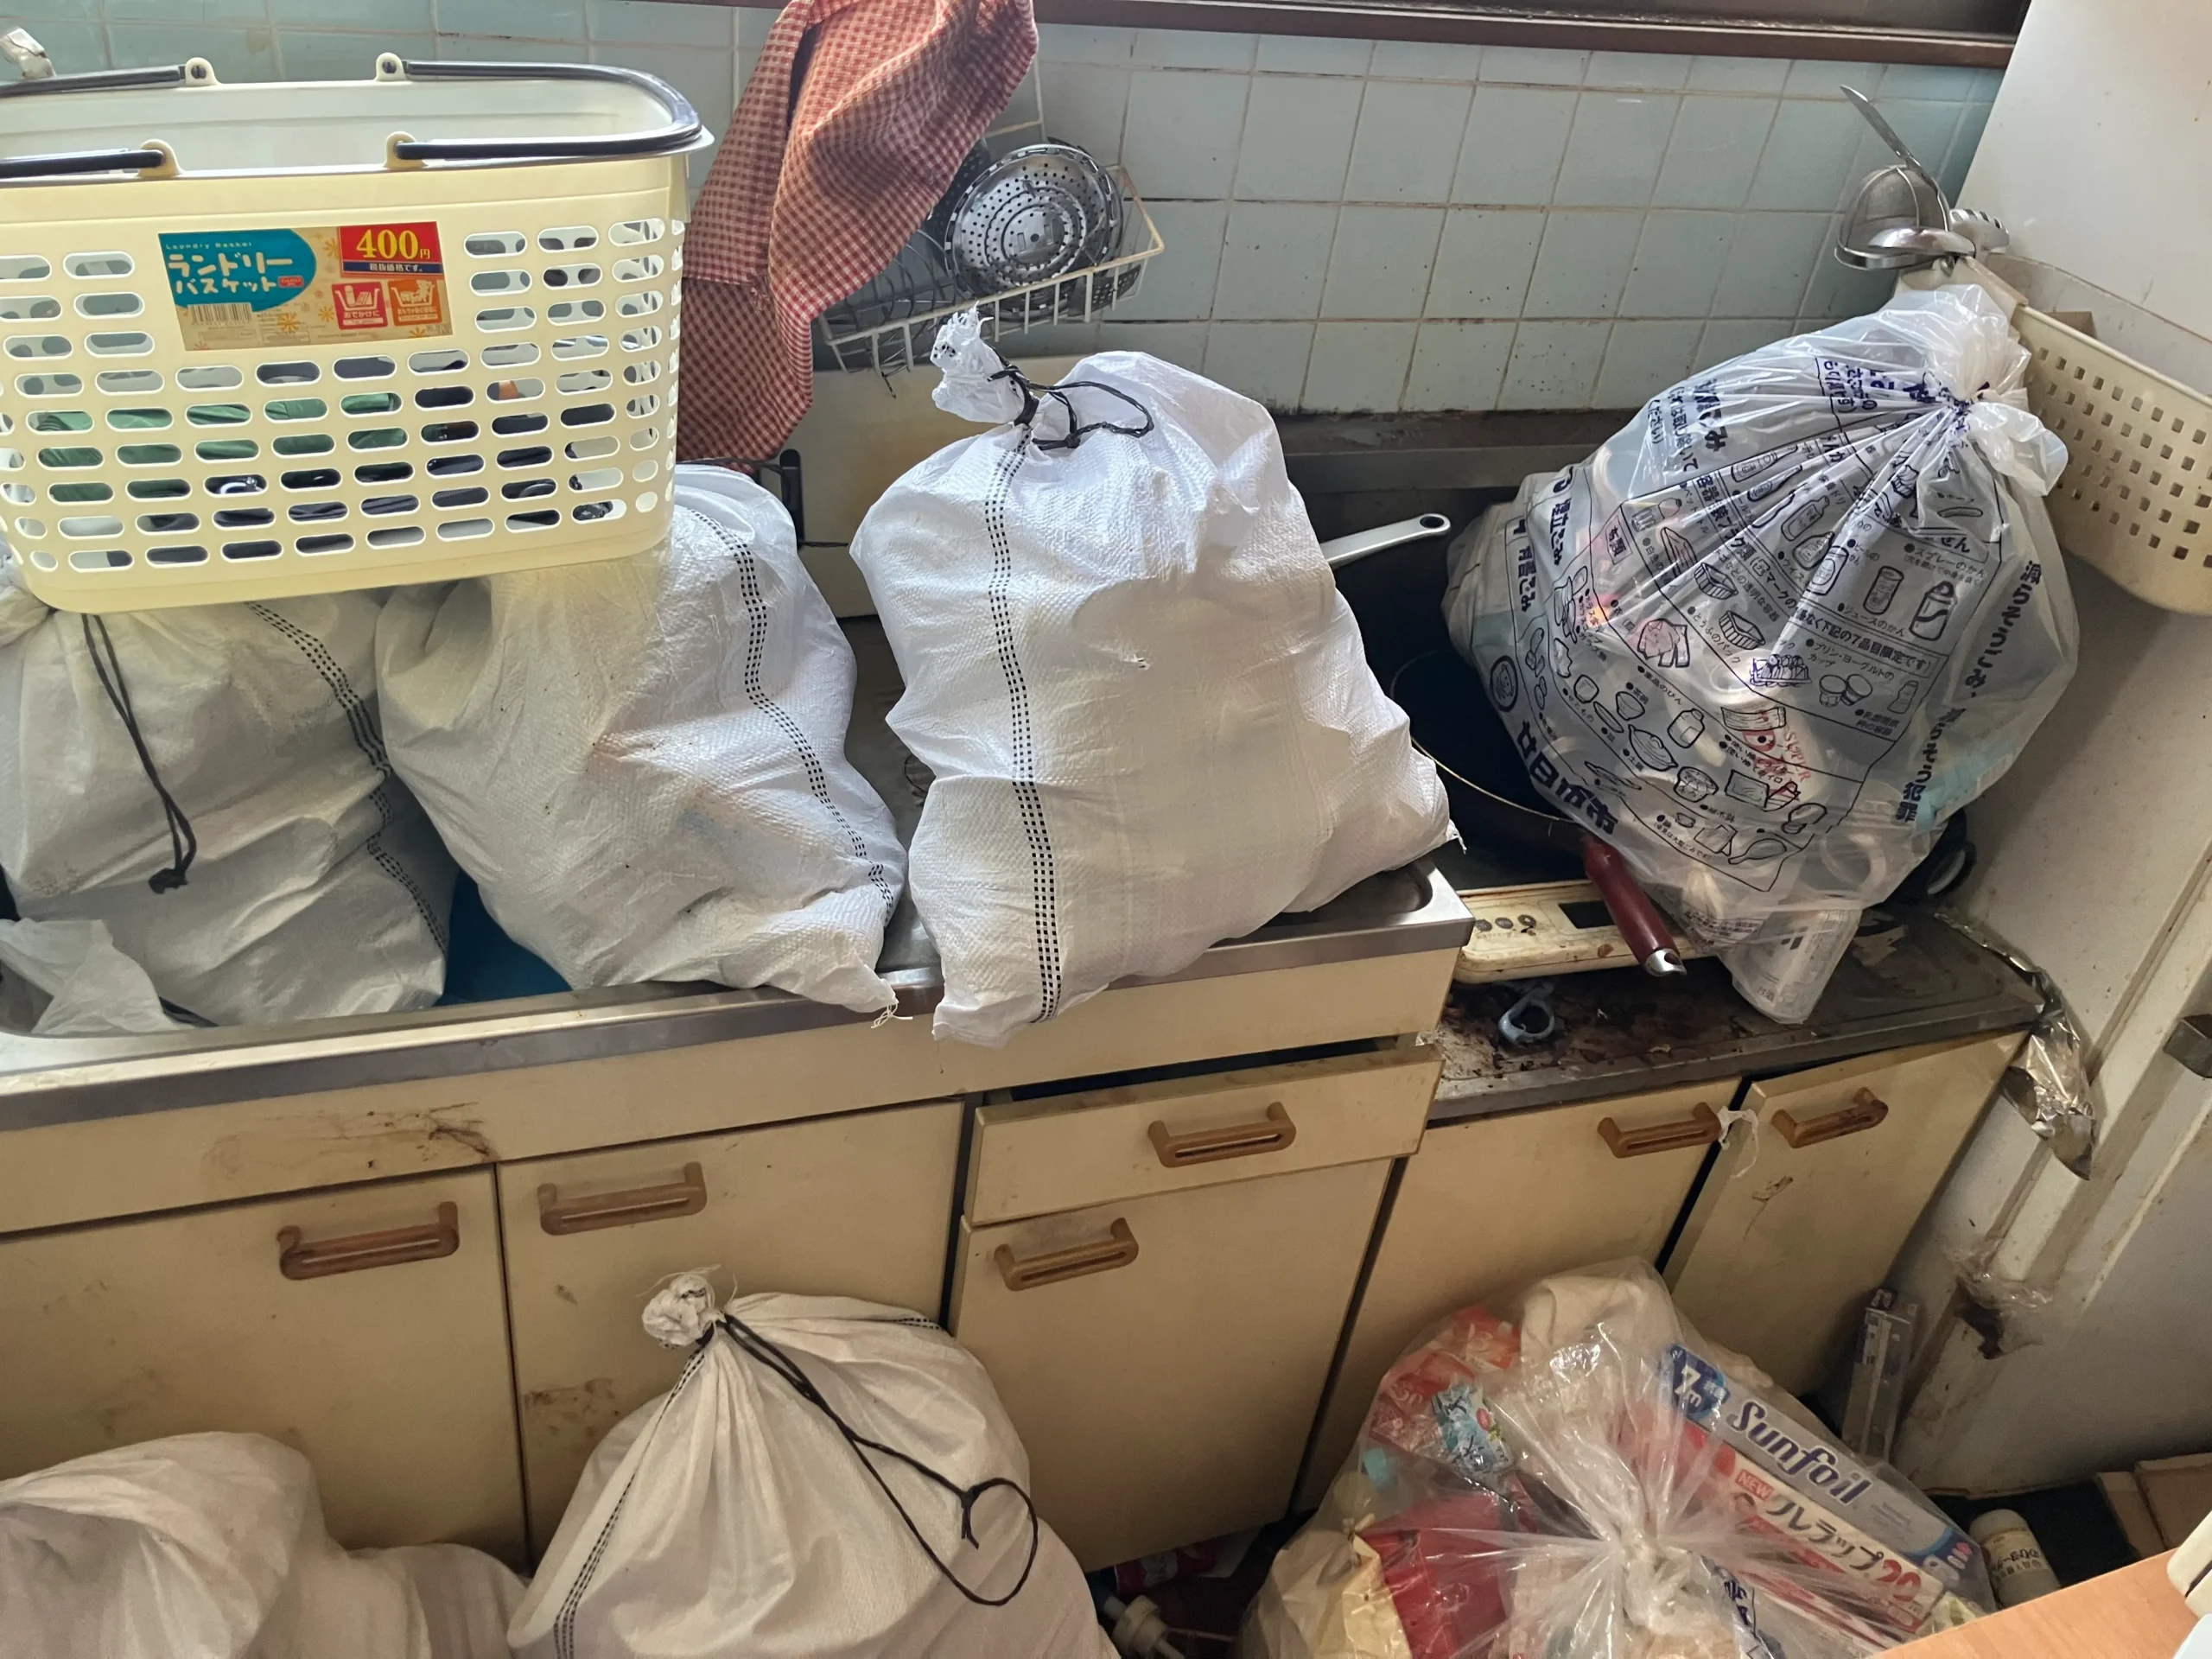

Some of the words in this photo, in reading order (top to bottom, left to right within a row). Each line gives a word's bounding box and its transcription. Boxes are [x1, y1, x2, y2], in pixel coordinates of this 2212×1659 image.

[356, 229, 430, 259] 400円
[168, 251, 293, 277] ランドリー
[175, 276, 276, 295] バスケット
[344, 310, 380, 319] おでかけに
[1727, 1398, 1873, 1506] Sunfoil
[1738, 1471, 1773, 1499] NEW
